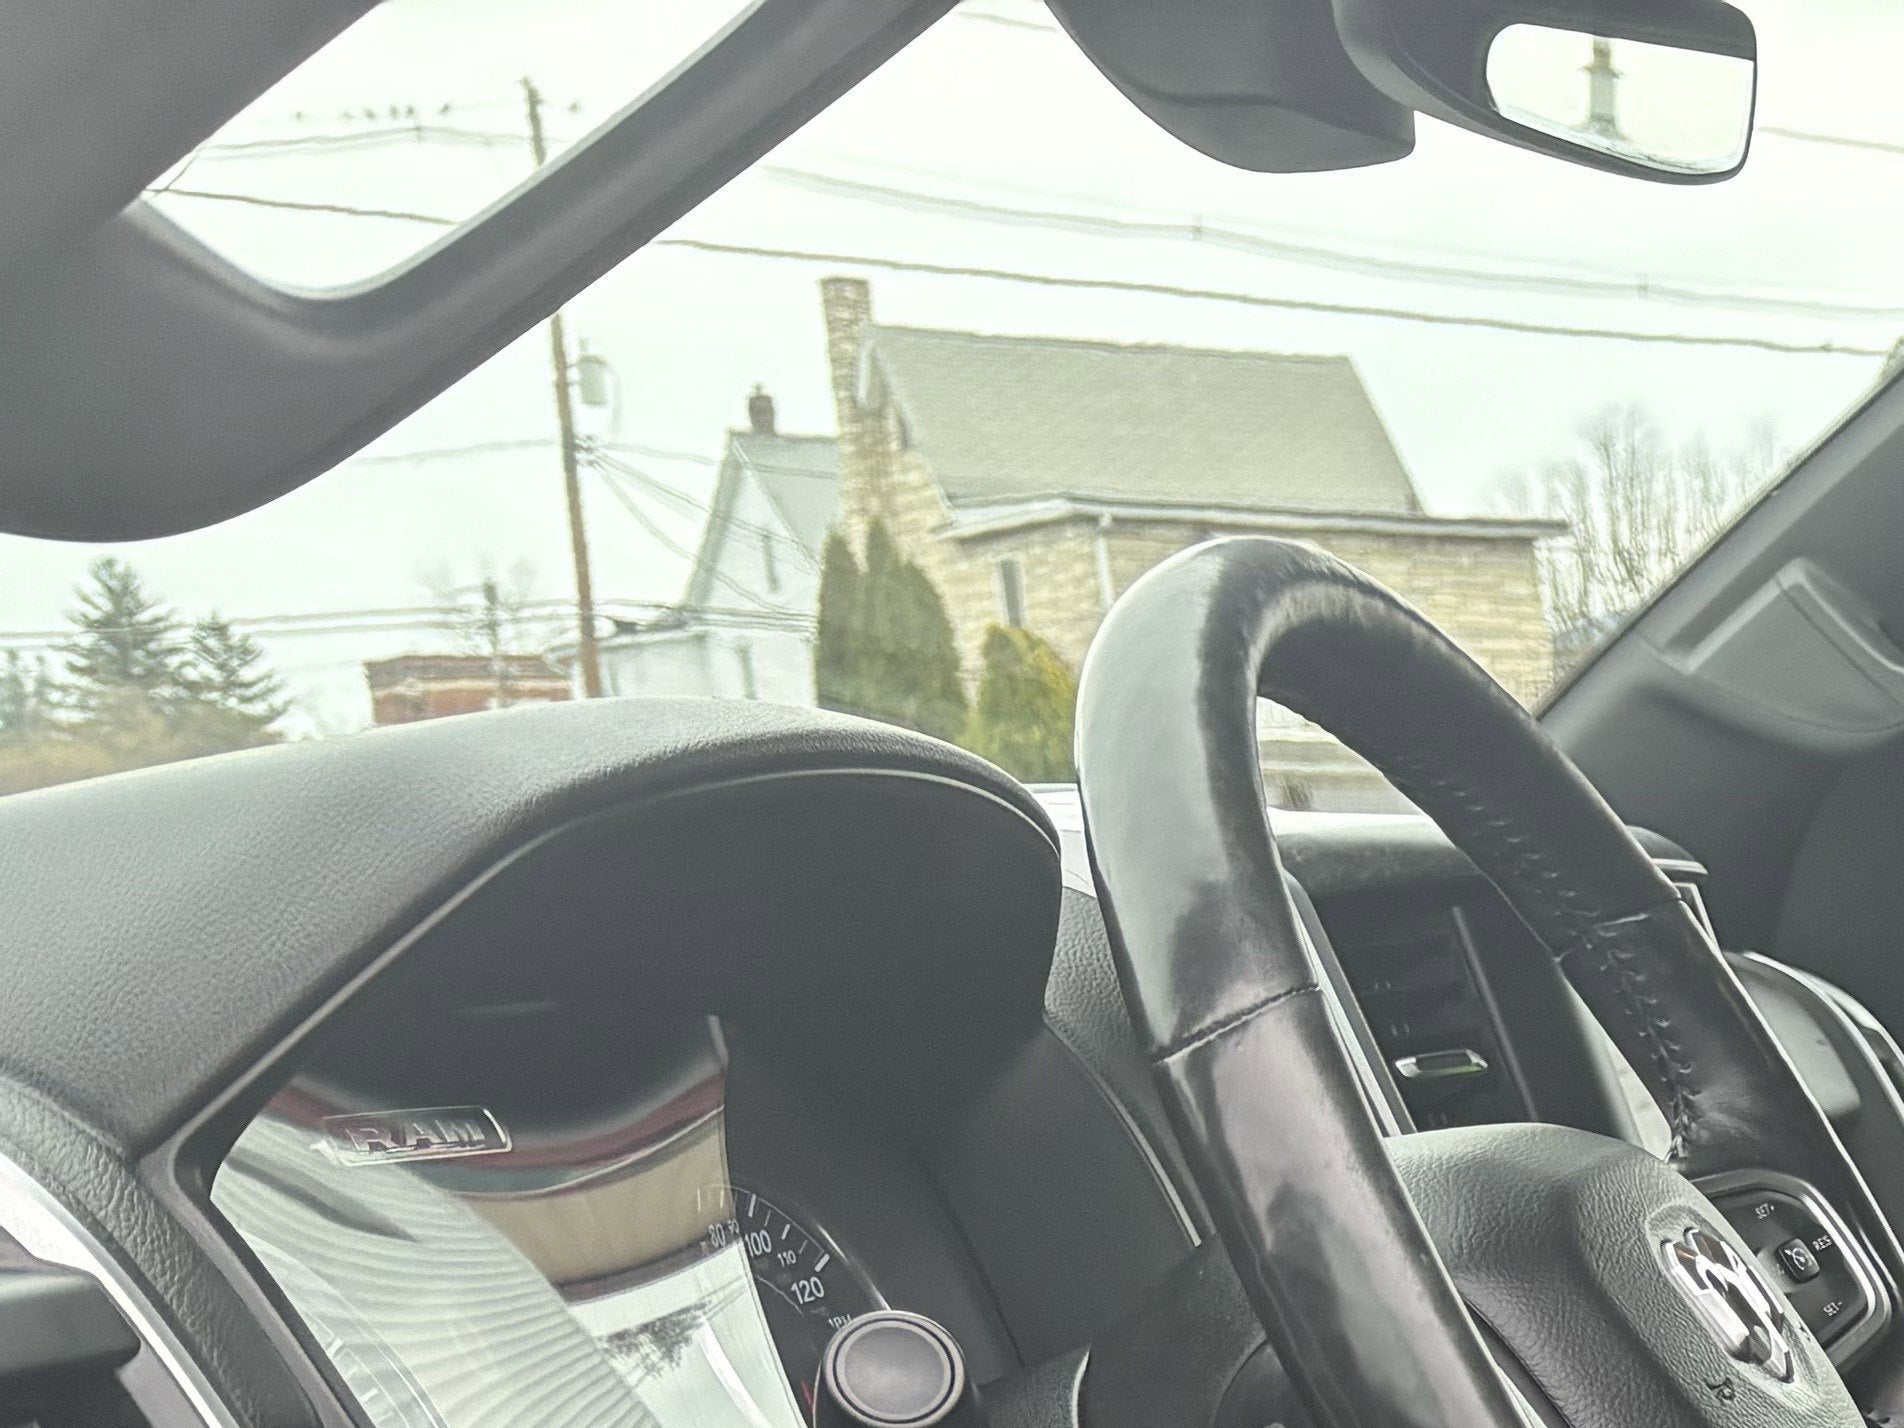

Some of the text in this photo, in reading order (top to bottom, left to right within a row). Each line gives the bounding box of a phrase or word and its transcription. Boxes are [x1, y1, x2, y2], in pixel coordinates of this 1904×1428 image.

[346, 1119, 486, 1153] RAM
[709, 1223, 726, 1248] 80
[744, 1229, 772, 1258] 100
[777, 1250, 797, 1267] 110
[791, 1276, 825, 1304] 120
